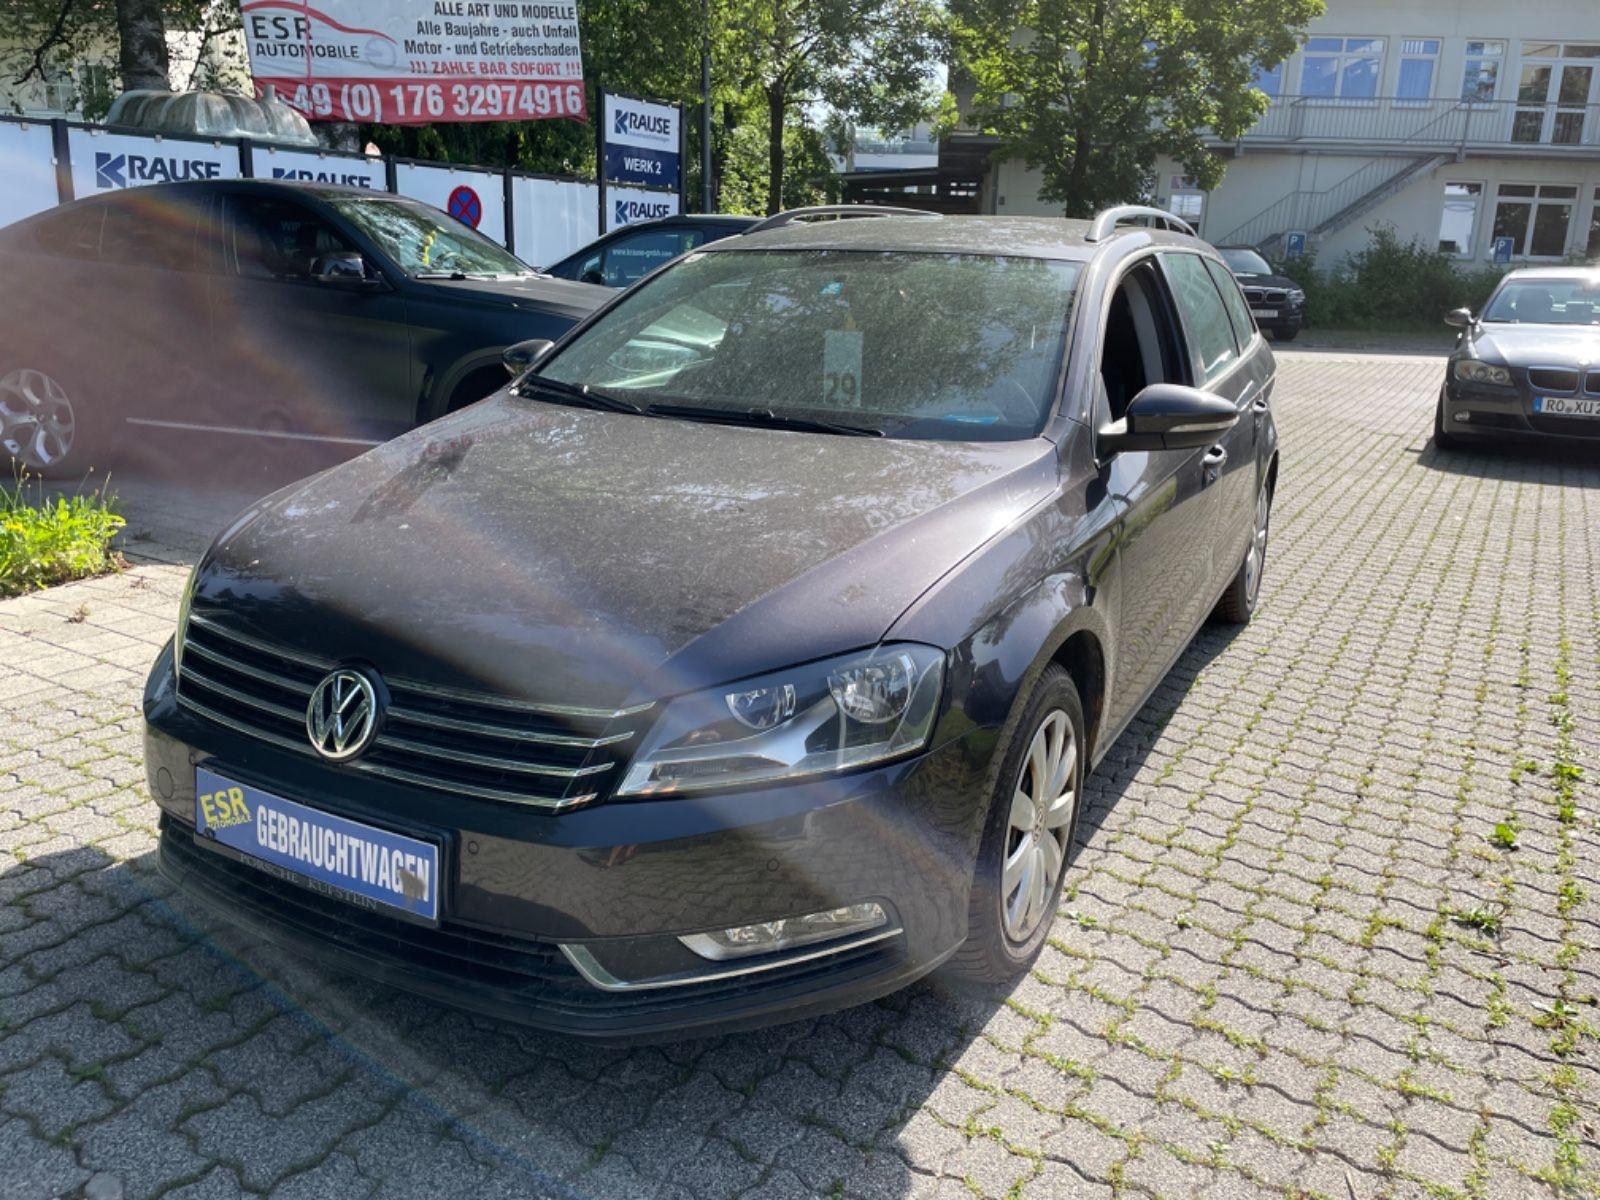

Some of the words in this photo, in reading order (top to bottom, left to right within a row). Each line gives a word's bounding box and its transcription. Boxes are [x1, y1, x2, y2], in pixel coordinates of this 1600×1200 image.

[434, 1, 464, 17] ALLE
[467, 3, 490, 18] ART
[494, 4, 518, 19] UND
[521, 4, 575, 20] MODELLE
[251, 15, 313, 40] ESR
[416, 20, 442, 36] Alle
[445, 21, 500, 39] Baujahre
[511, 24, 540, 38] auch
[542, 24, 578, 39] Unfall
[256, 42, 360, 59] AUTOMOBILE
[404, 39, 442, 55] Motor
[454, 42, 477, 55] und
[480, 42, 579, 57] Getriebeschaden
[431, 61, 476, 75] ZAHLE
[479, 61, 508, 75] BAR
[510, 61, 561, 76] SOFORT
[565, 62, 581, 76] !!!
[340, 83, 382, 123] (0)
[391, 83, 445, 117] 176
[451, 83, 582, 117] 32974916
[614, 109, 671, 136] KRAUSE
[95, 152, 221, 188] KRAUSE
[624, 156, 654, 174] WERK
[655, 161, 662, 176] 2
[615, 200, 671, 224] KRAUSE
[1290, 235, 1298, 246] P
[1498, 240, 1505, 251] P
[826, 371, 857, 405] 29
[1546, 399, 1565, 412] RO
[1574, 401, 1593, 414] XU
[200, 787, 250, 823] ESR
[256, 804, 430, 903] GEBRAUCHTWAGEN
